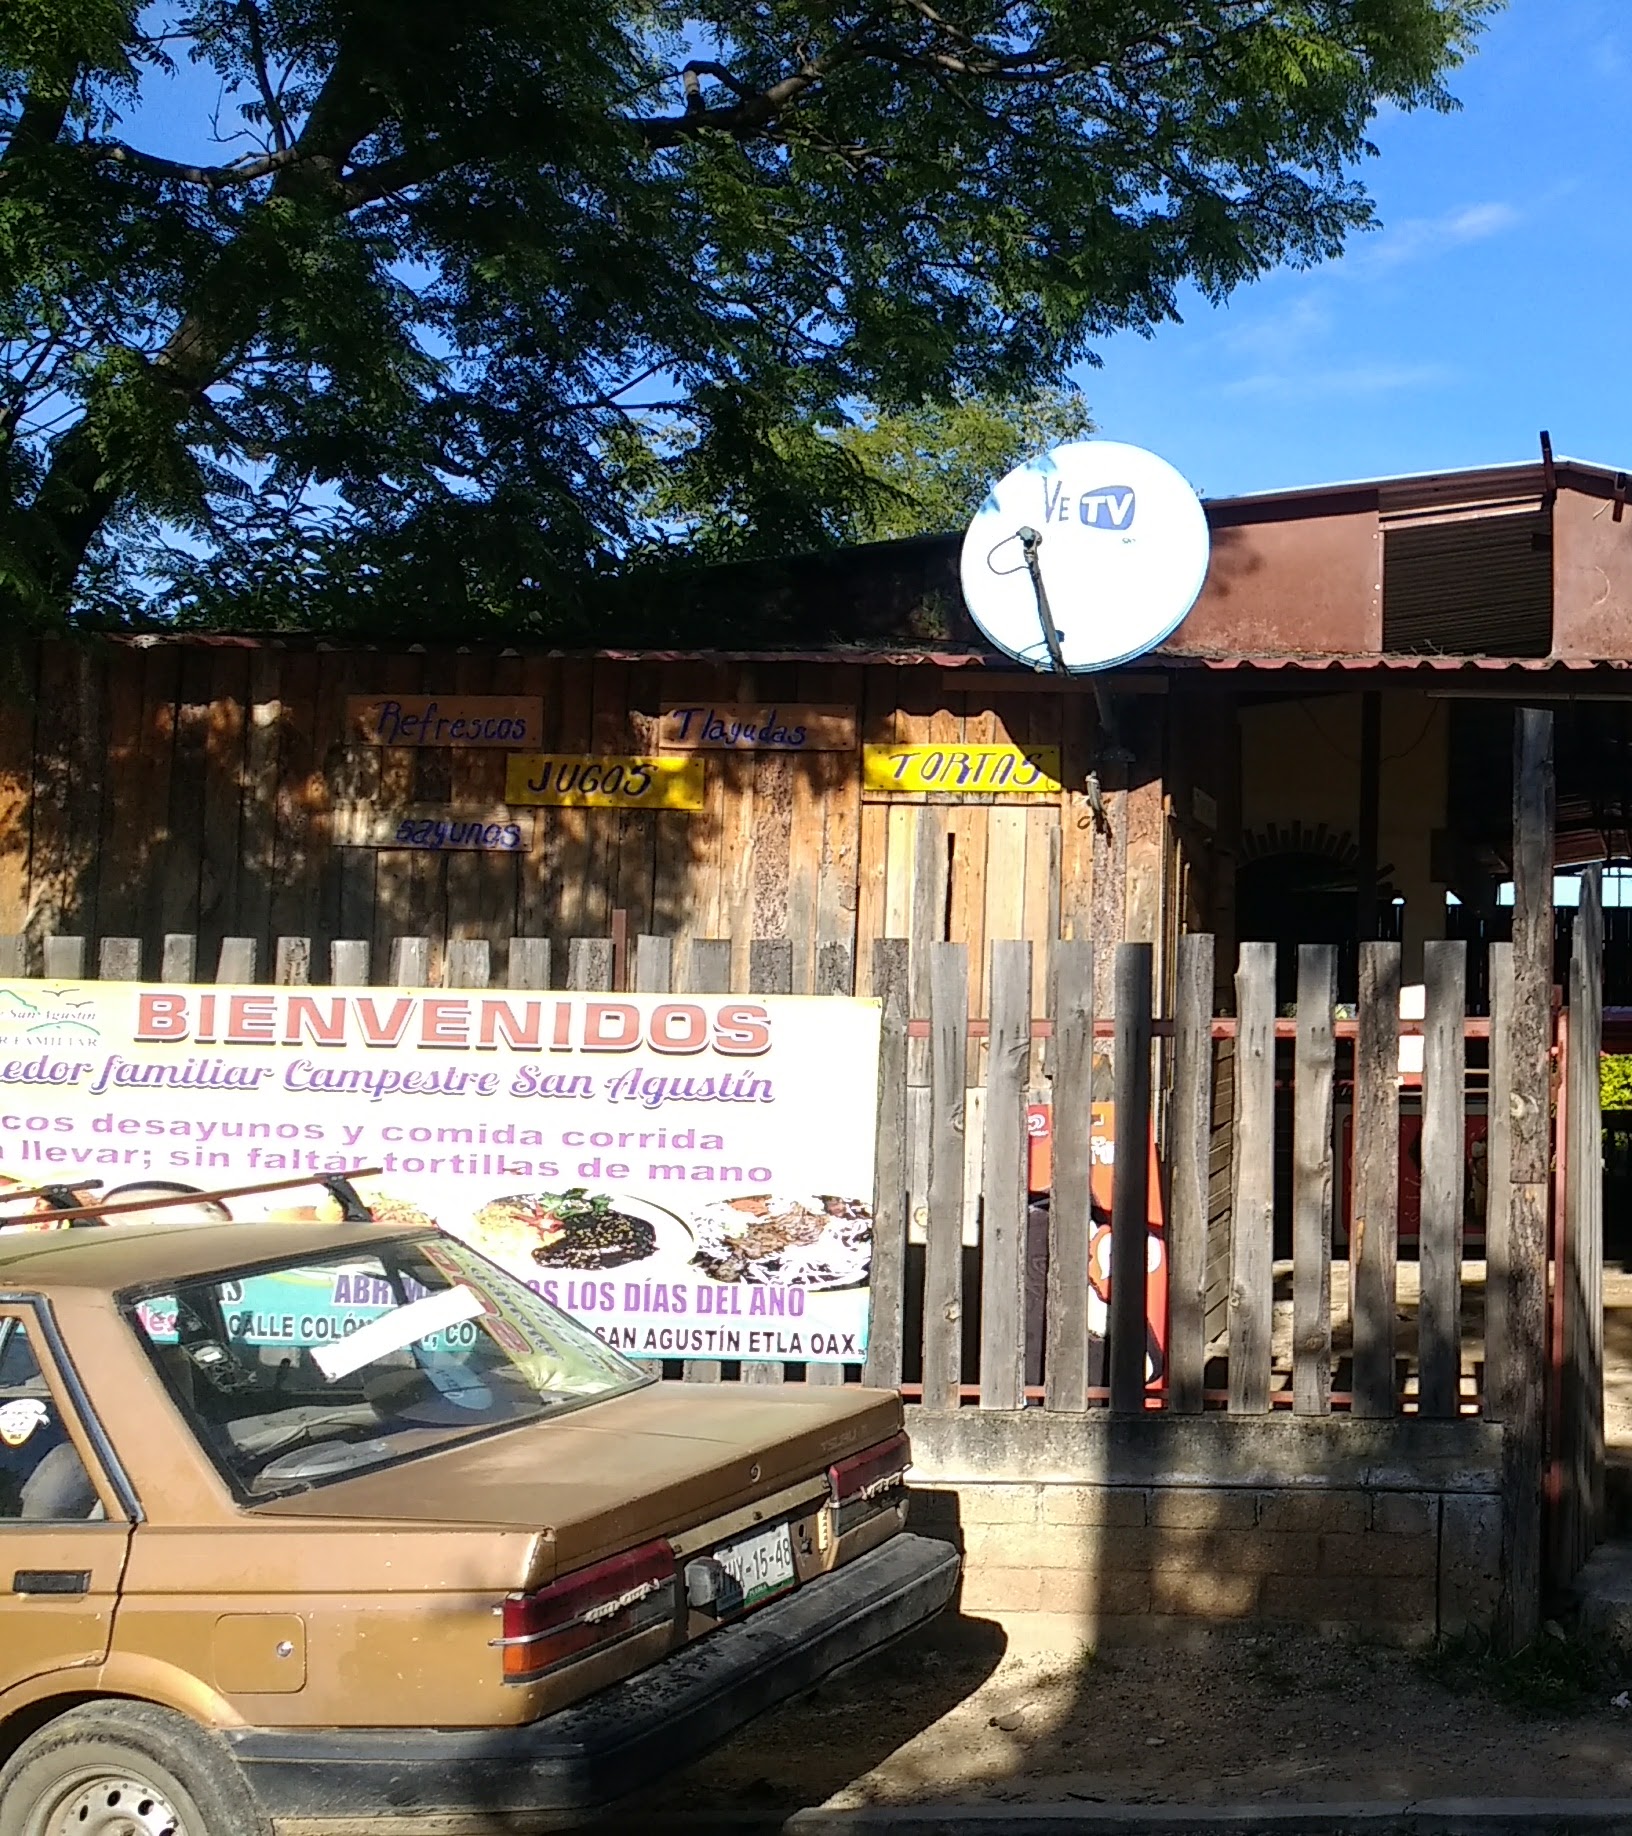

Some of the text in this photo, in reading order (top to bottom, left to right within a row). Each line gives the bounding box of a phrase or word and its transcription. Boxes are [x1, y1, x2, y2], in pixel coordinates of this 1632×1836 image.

[1082, 493, 1133, 525] TV
[376, 701, 527, 744] Refrescos
[673, 708, 806, 745] Tlayudas
[528, 762, 659, 796] JUGOS
[890, 751, 1043, 785] TORTAS
[134, 992, 773, 1054] BIENVENIDOS
[89, 1055, 275, 1095] familiar
[283, 1059, 498, 1101] Campestre
[510, 1064, 593, 1099] San
[606, 1067, 776, 1108] Agustín
[92, 1113, 325, 1143] desayunos
[342, 1126, 365, 1146] y
[381, 1121, 545, 1147] comida
[562, 1126, 725, 1151] corrida
[22, 1140, 150, 1169] llevar;
[169, 1146, 230, 1168] sin
[247, 1148, 368, 1170] faltar
[383, 1152, 559, 1178] tortillas
[577, 1156, 630, 1181] de
[648, 1164, 774, 1184] mano
[568, 1280, 615, 1311] LOS
[624, 1277, 687, 1314] DÍAS
[696, 1284, 742, 1315] DEL
[749, 1280, 805, 1317] AÑO
[229, 1315, 293, 1337] CALLE
[594, 1326, 637, 1349] SAN
[643, 1325, 740, 1353] AGUSTÍN
[749, 1332, 803, 1354] ETLA
